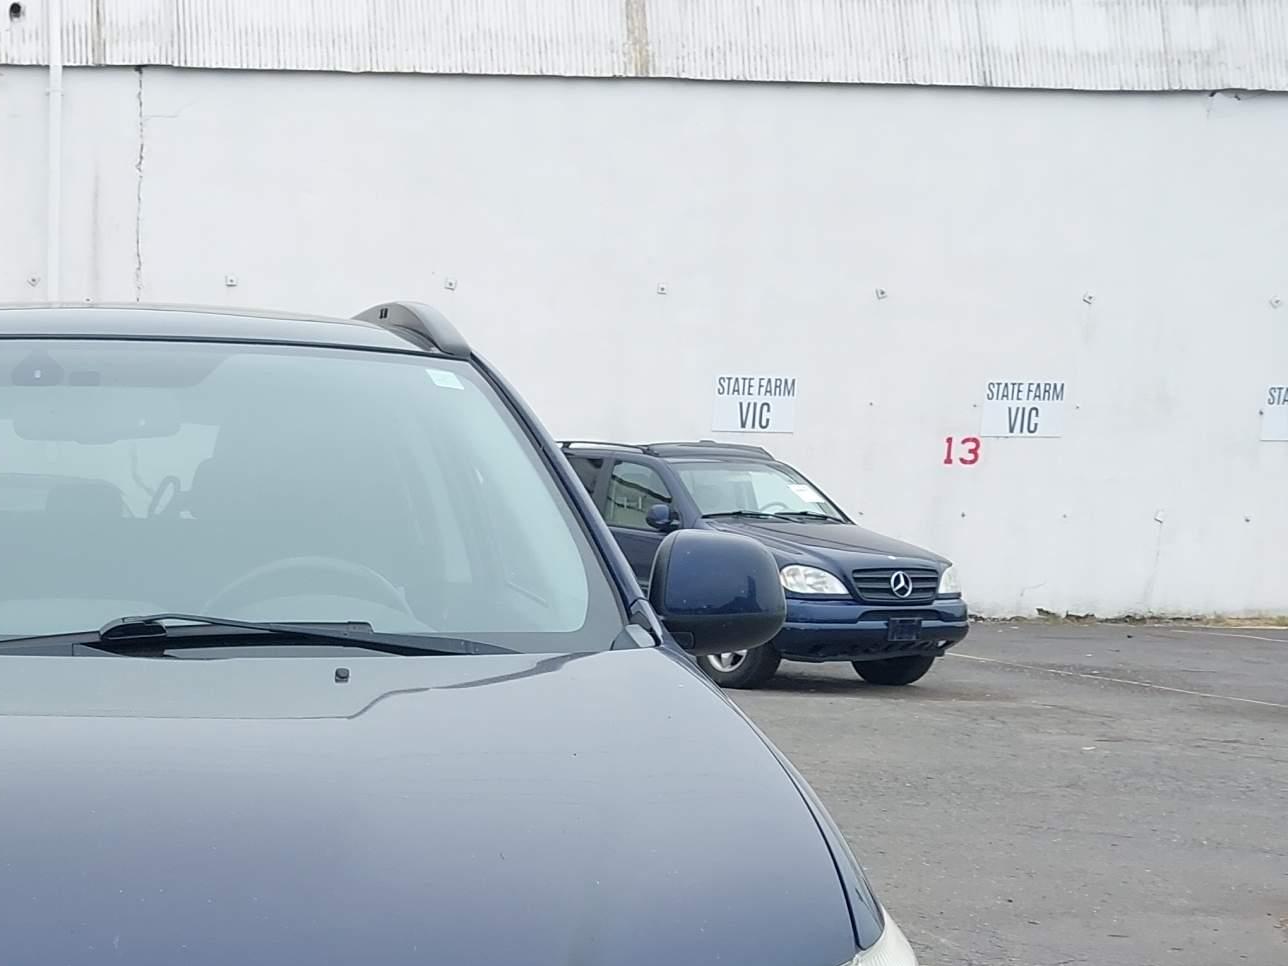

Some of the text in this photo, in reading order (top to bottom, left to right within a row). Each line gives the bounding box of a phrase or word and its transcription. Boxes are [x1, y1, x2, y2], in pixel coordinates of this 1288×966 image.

[716, 376, 796, 397] STATE FARM
[986, 382, 1065, 402] STATE FARM
[738, 401, 771, 430] VIC
[1006, 406, 1040, 434] VIC
[943, 436, 981, 466] 13
